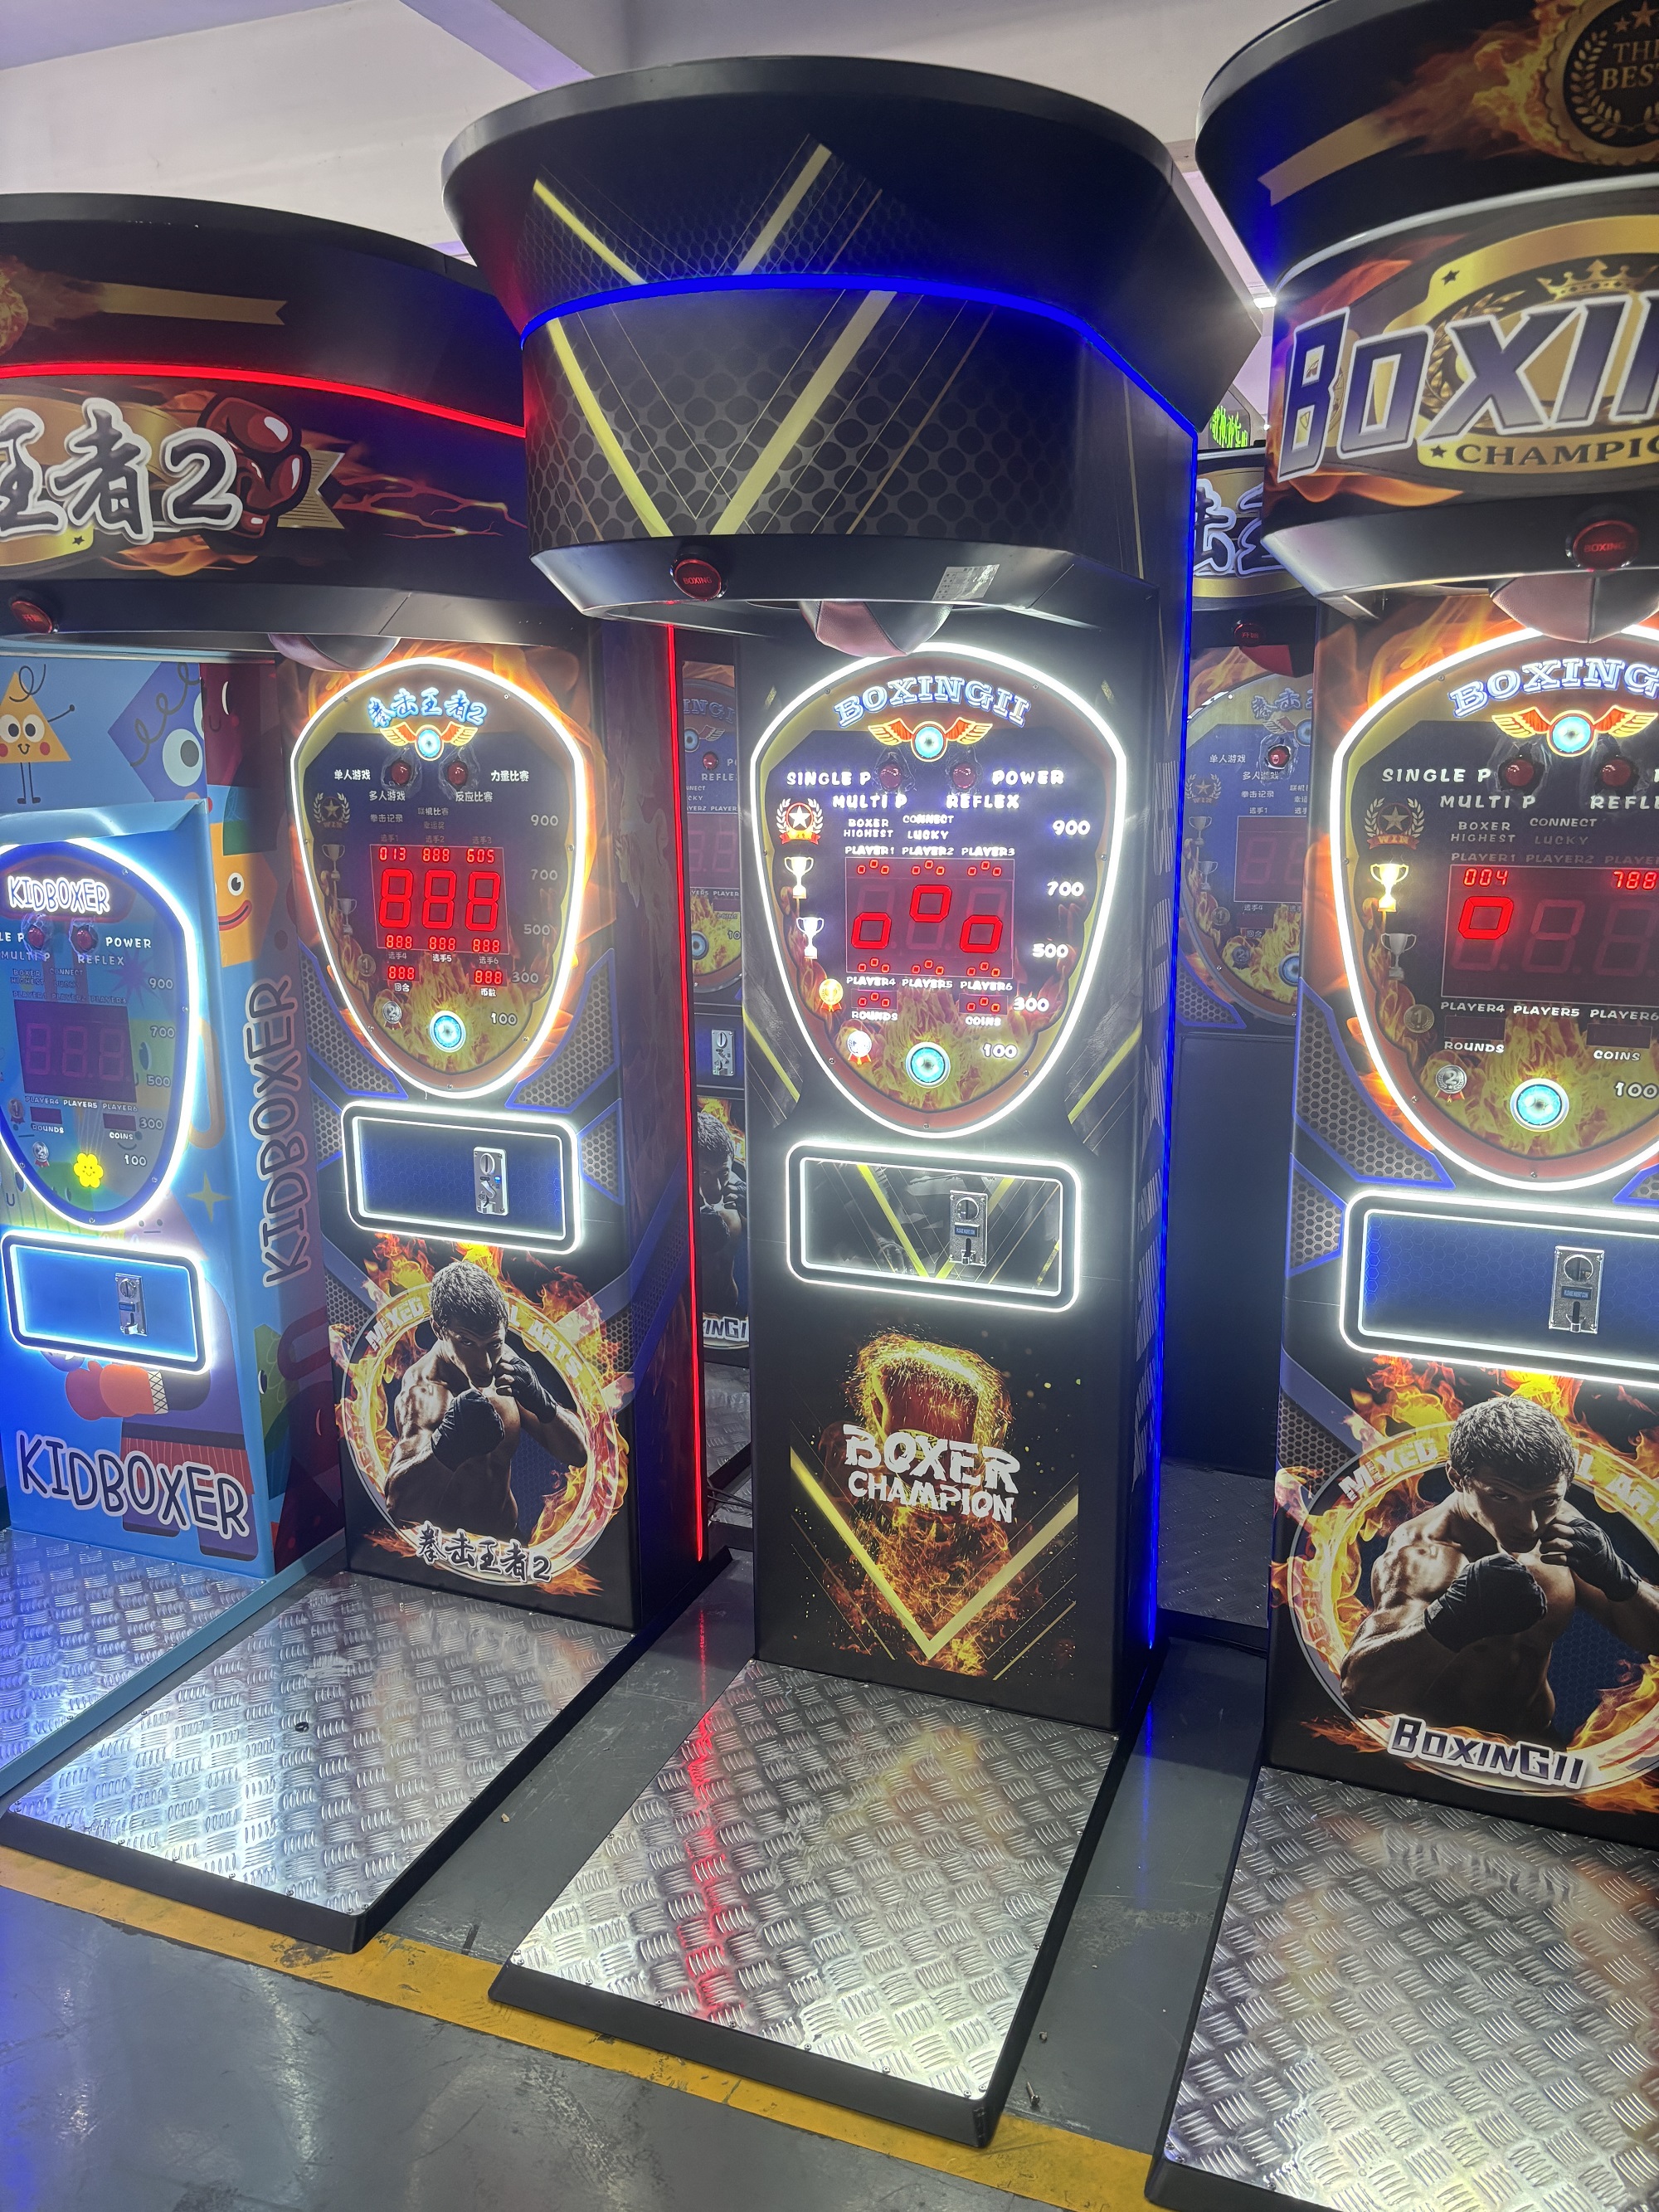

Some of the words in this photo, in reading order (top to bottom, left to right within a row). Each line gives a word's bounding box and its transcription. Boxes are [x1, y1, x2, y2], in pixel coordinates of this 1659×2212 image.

[1601, 64, 1659, 90] BES
[1584, 542, 1626, 553] BOXING
[683, 576, 713, 585] BOXING
[367, 687, 488, 728] 拳击王者2
[834, 675, 1029, 728] BOXINGII
[1209, 754, 1246, 763] 单人游戏
[334, 769, 371, 781] 单人游戏
[491, 770, 529, 782] 力量比赛
[702, 773, 737, 782] REFLE
[786, 771, 852, 786] SINGLE
[859, 772, 871, 785] P
[992, 770, 1064, 786] POWER
[1382, 768, 1466, 782] SINGLE
[1477, 768, 1491, 782] P
[369, 790, 406, 801] 多人游戏
[455, 791, 493, 802] 反应比赛
[832, 794, 888, 808] MULTI
[895, 795, 907, 808] P
[946, 794, 1019, 809] REFLEX
[1440, 795, 1511, 809] MULTI
[1522, 797, 1535, 809] P
[531, 815, 559, 826] 900
[849, 818, 889, 828] BOXER
[902, 814, 954, 824] CONNECT
[1458, 821, 1511, 831] BOXER
[1530, 818, 1598, 828] CONNECT
[844, 829, 893, 839] HIGHEST
[907, 830, 949, 840] LUCKY
[1053, 820, 1090, 836] 900
[1378, 835, 1409, 845] WIN
[1451, 833, 1515, 843] HIGHEST
[1535, 836, 1588, 845] LUCKY
[379, 846, 406, 861] 013
[422, 848, 450, 863] 888
[844, 845, 895, 856] PLAYER1
[902, 846, 954, 856] PLAYER2
[961, 846, 1015, 857] PLAYER3
[1452, 852, 1515, 862] PLAYER1
[1525, 855, 1594, 864] PLAYER2
[530, 869, 558, 881] 700
[1463, 868, 1508, 886] 004
[8, 876, 110, 914] KIDBOXER
[1047, 881, 1084, 897] 700
[523, 923, 551, 936] 500
[105, 937, 152, 948] POWER
[386, 934, 413, 949] 888
[428, 936, 456, 951] 888
[472, 938, 500, 953] 888
[1032, 943, 1068, 959] 500
[78, 955, 124, 966] REFLEX
[388, 965, 416, 980] 888
[474, 970, 503, 985] 888
[511, 972, 538, 984] 300
[148, 977, 173, 989] 900
[394, 983, 410, 992] 回合
[846, 976, 896, 987] PLAYER4
[902, 978, 953, 989] PLAYER5
[961, 981, 1013, 992] PLAYER6
[1013, 997, 1049, 1012] 300
[1441, 1001, 1506, 1013] PLAYER4
[1513, 1005, 1580, 1017] PLAYER5
[490, 1012, 518, 1026] 100
[852, 1011, 898, 1021] ROUNDS
[966, 1016, 1001, 1026] COINS
[150, 1026, 175, 1038] 700
[983, 1044, 1018, 1059] 100
[1444, 1041, 1505, 1054] ROUNDS
[1593, 1050, 1641, 1061] COINS
[147, 1075, 171, 1087] 500
[25, 1096, 59, 1104] PLAYER4
[63, 1100, 98, 1108] PLAYER5
[103, 1104, 139, 1112] PLAYER6
[139, 1118, 164, 1129] 300
[32, 1124, 64, 1133] ROUNDS
[109, 1132, 134, 1140] COINS
[243, 975, 311, 1288] KIDBOXER
[124, 1155, 147, 1167] 100
[365, 1297, 424, 1352] MIXED
[528, 1319, 582, 1378] ARTS
[843, 1424, 1020, 1493] BOXER
[1338, 1438, 1438, 1502] MIXED
[17, 1430, 250, 1539] KIDBOXER
[848, 1471, 1015, 1523] CHAMPION
[416, 1521, 552, 1583] 拳击王者2
